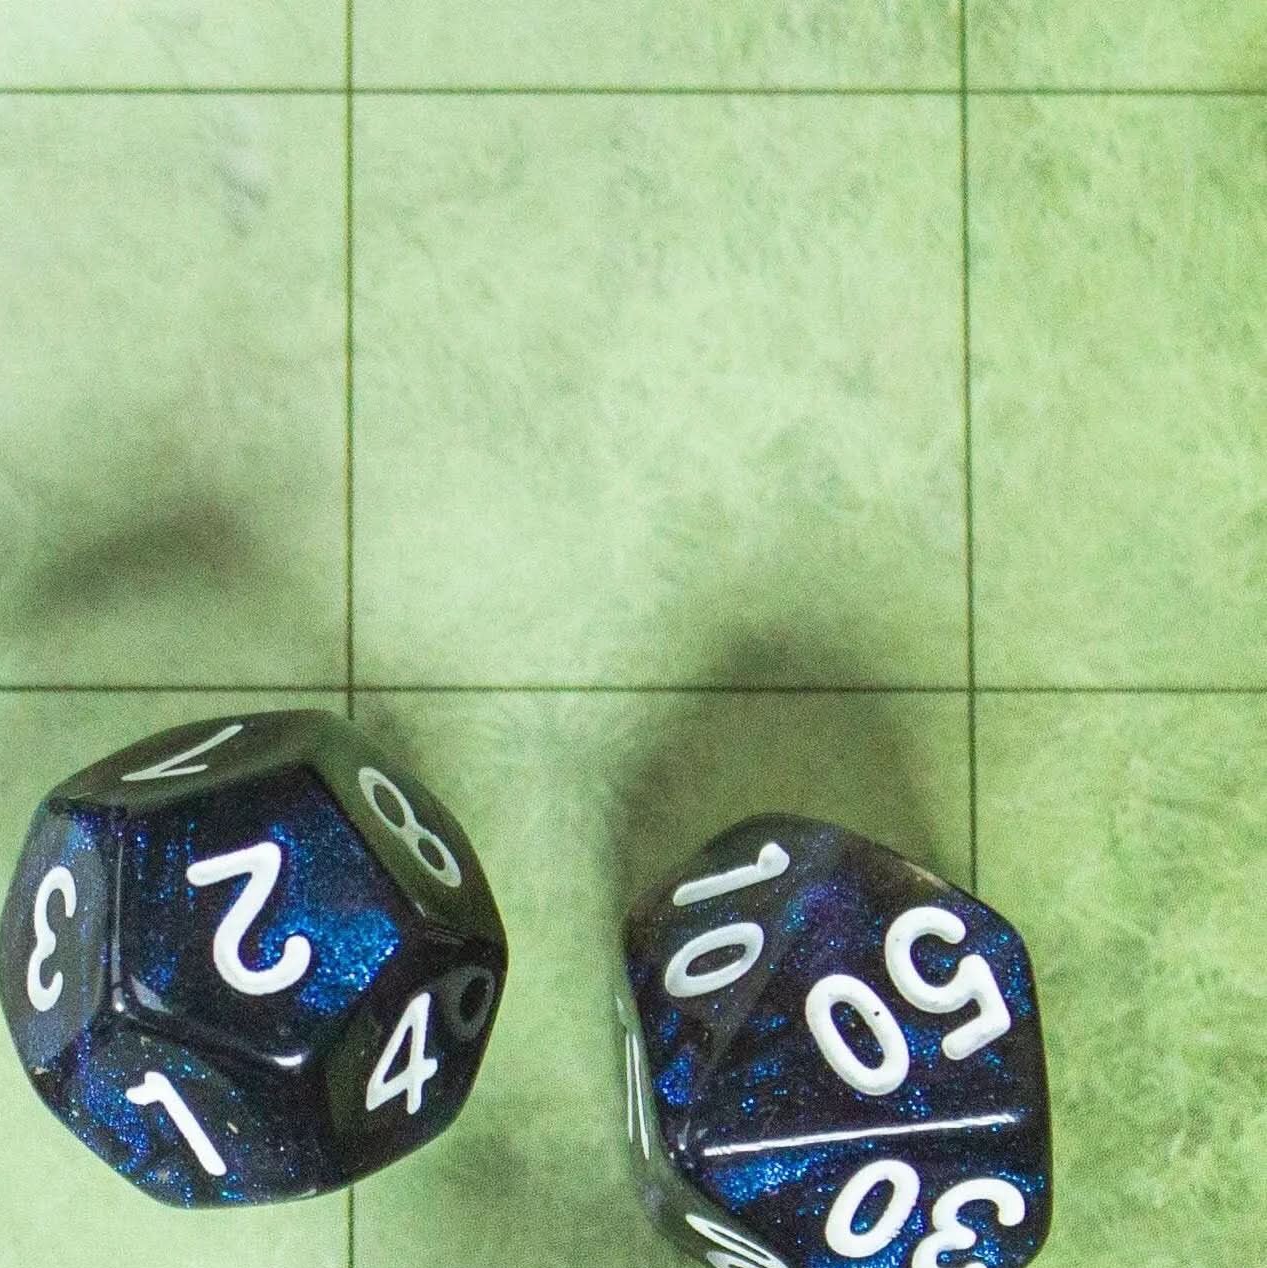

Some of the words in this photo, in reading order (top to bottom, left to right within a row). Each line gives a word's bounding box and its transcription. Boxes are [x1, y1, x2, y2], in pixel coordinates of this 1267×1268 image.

[356, 764, 464, 889] 8
[25, 864, 79, 1014] 3
[185, 840, 312, 996] 2
[663, 840, 792, 1000] 10
[364, 991, 439, 1116] 4
[804, 905, 1012, 1097] 50
[124, 1070, 228, 1177] 1
